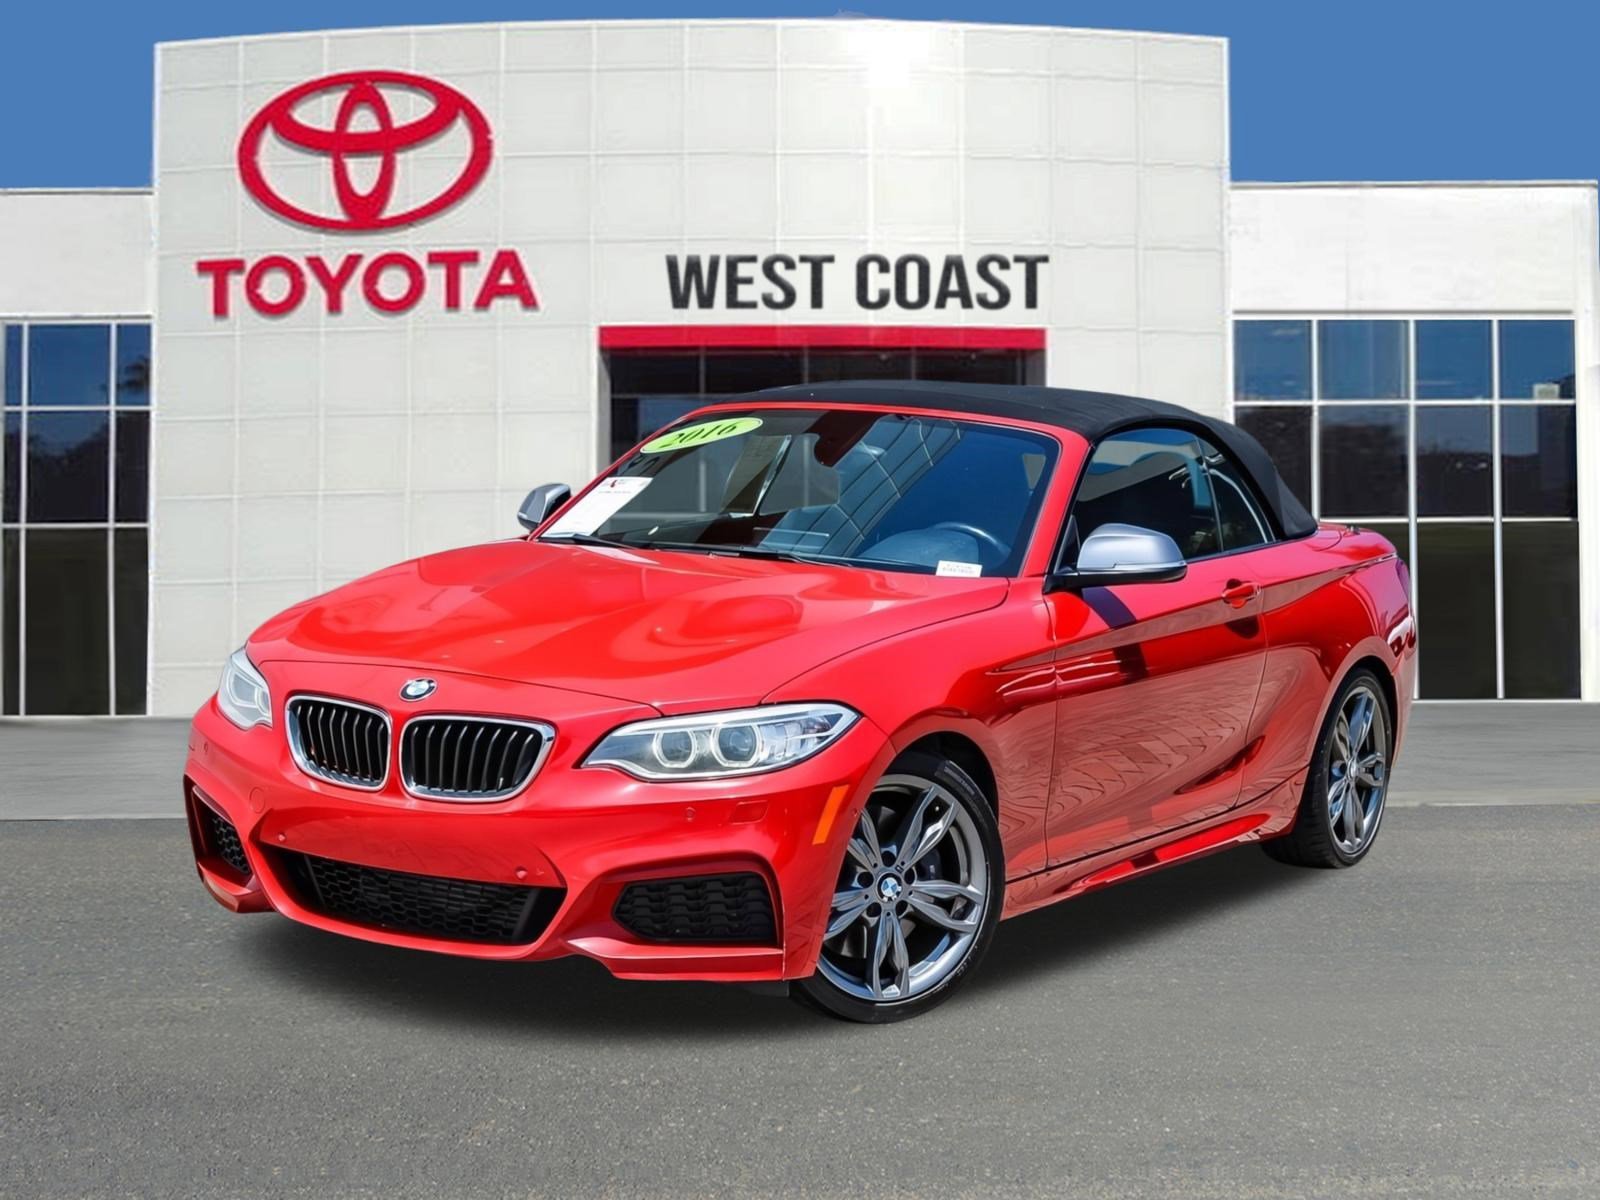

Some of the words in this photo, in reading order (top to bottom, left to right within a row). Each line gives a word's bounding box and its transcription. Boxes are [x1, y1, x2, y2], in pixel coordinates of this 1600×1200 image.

[197, 250, 538, 318] TOYOTA
[665, 254, 835, 310] WEST
[855, 254, 1050, 310] COAST
[659, 421, 740, 449] 2016
